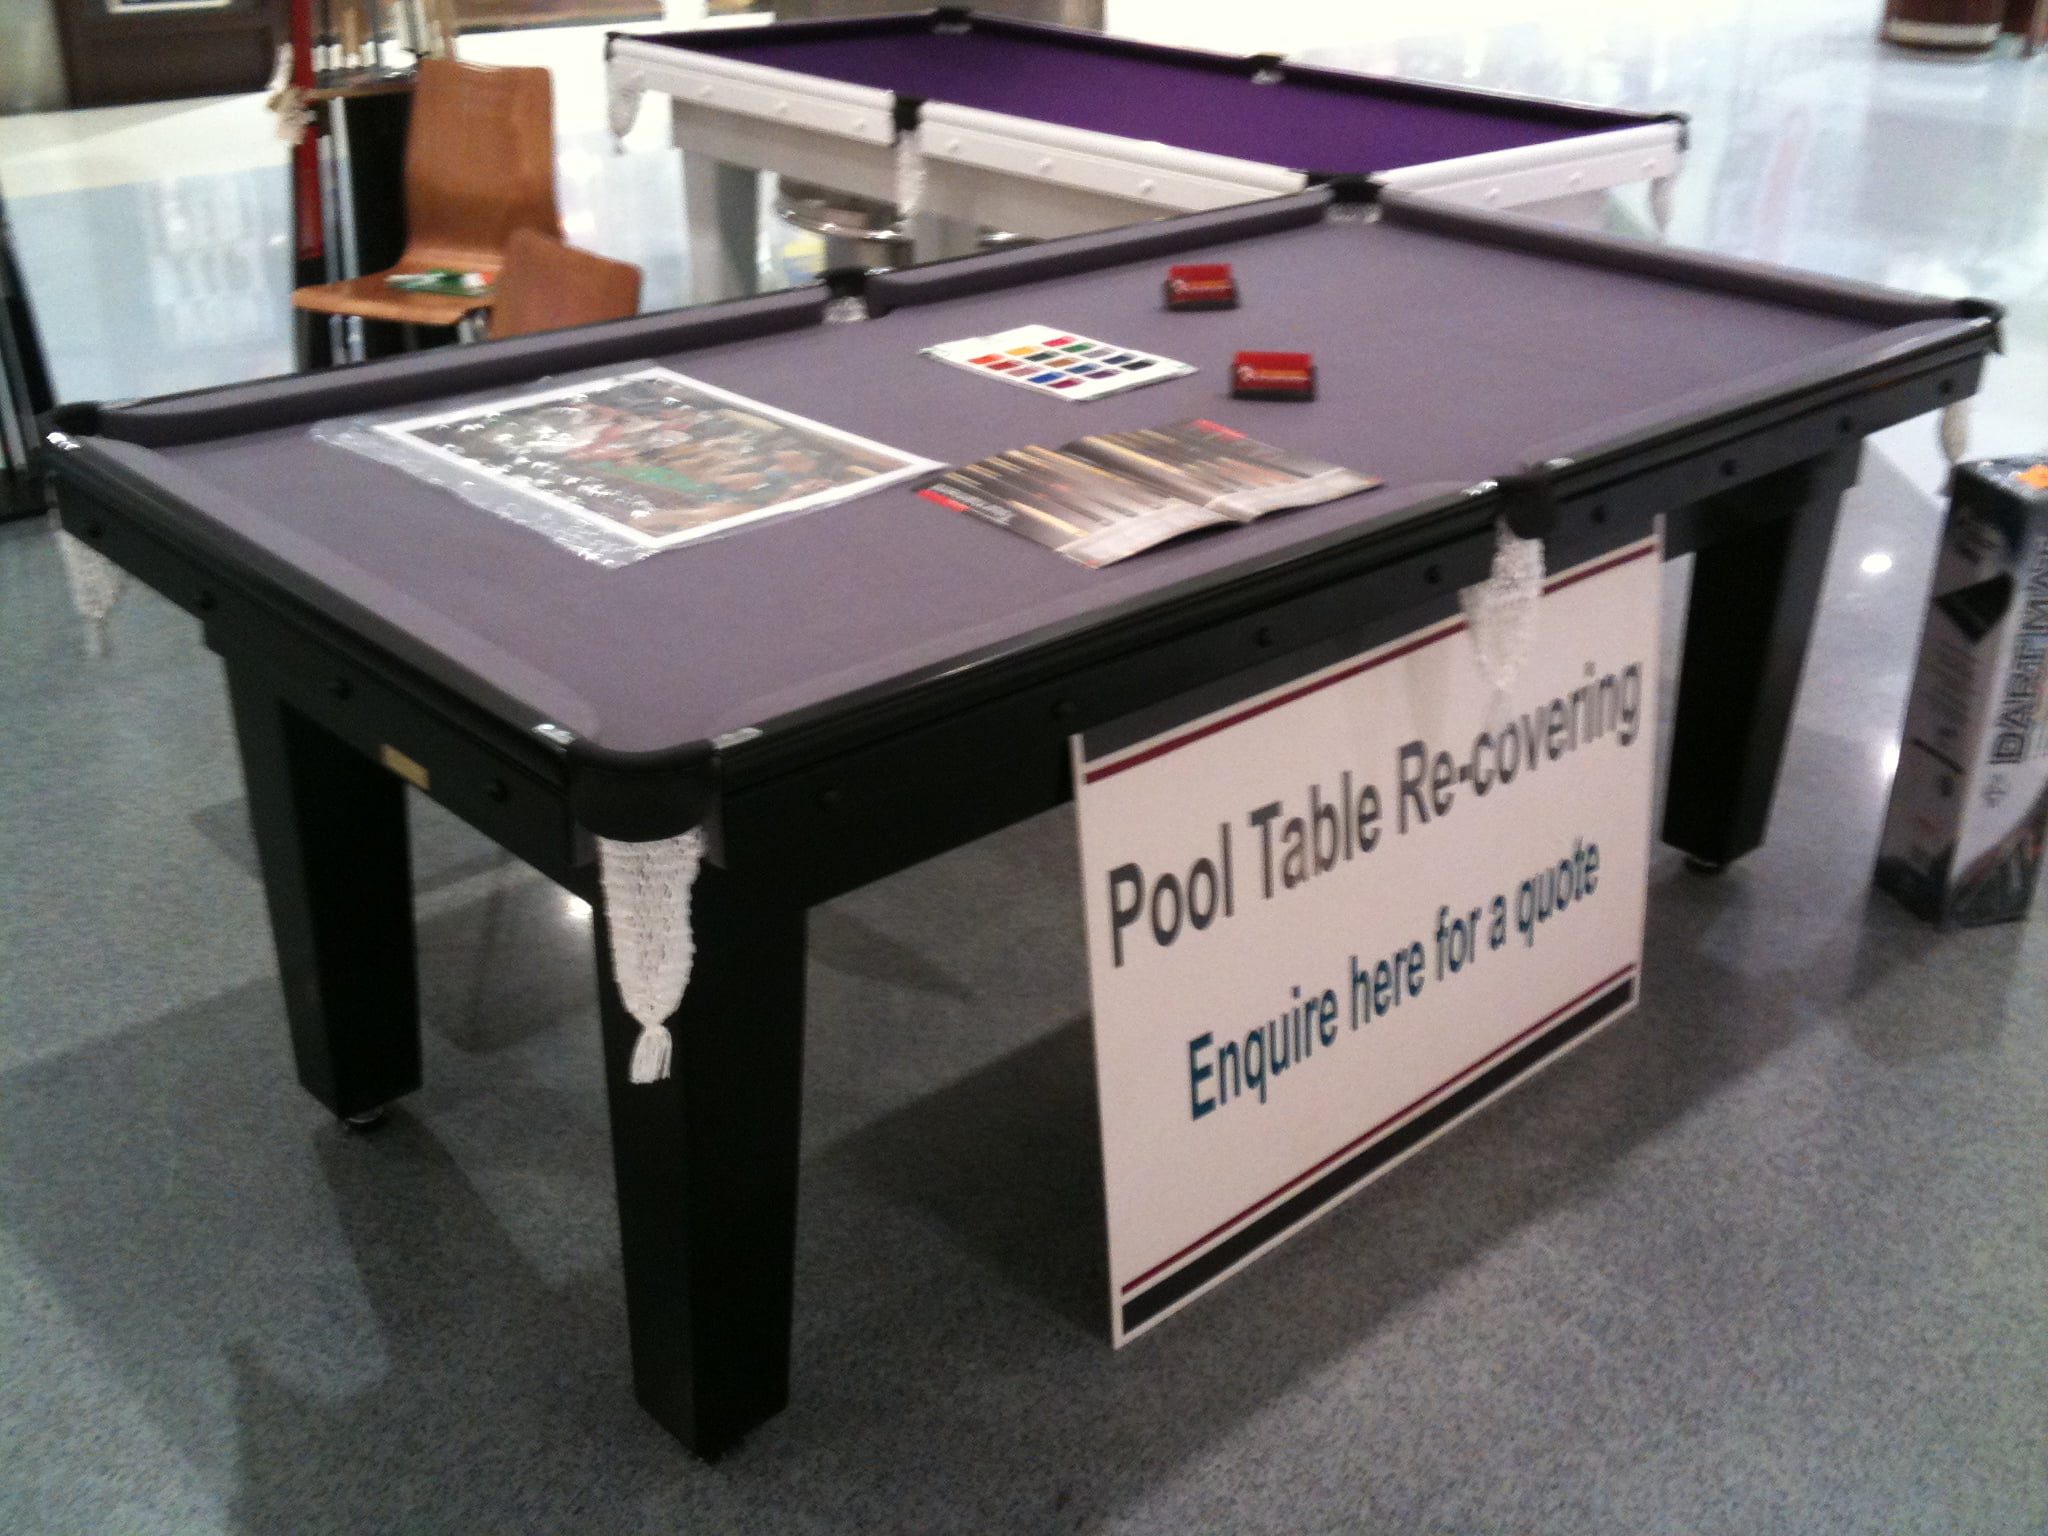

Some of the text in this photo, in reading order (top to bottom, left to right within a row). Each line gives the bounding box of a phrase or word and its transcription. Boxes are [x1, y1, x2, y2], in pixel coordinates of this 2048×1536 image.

[1105, 660, 1643, 970] Pool Table Re-covering
[1186, 836, 1600, 1123] Enquire here for a quote
